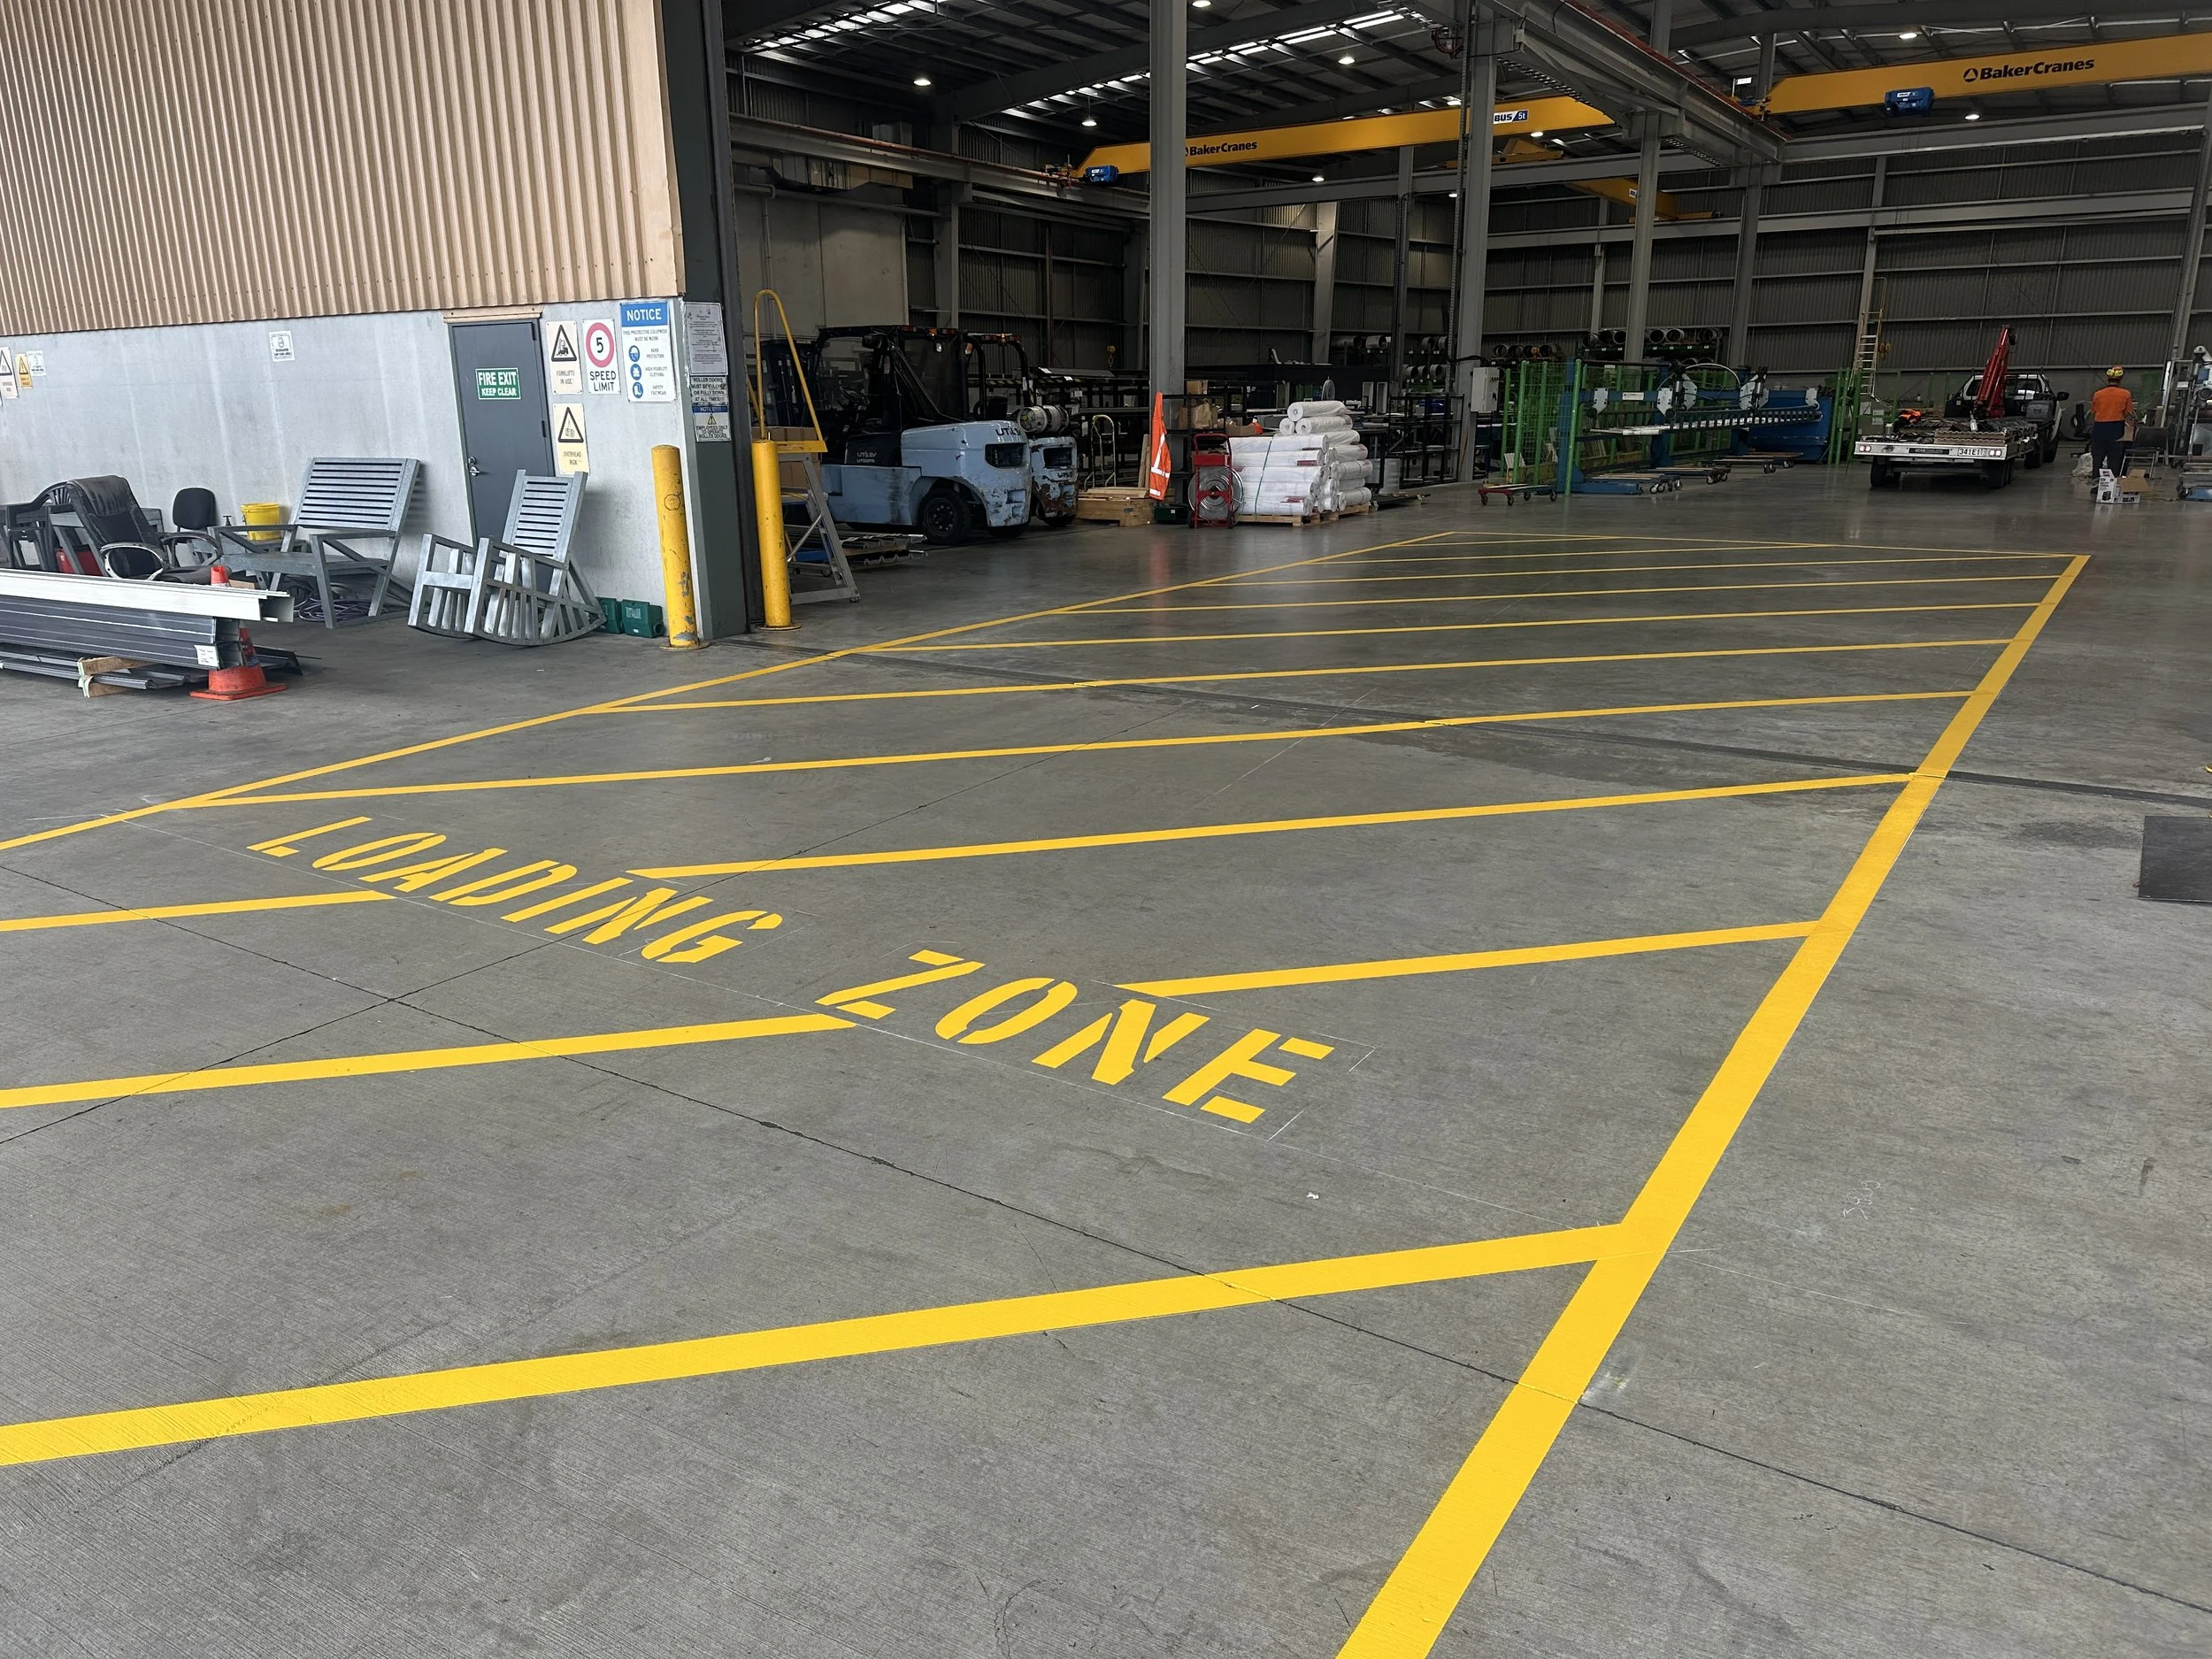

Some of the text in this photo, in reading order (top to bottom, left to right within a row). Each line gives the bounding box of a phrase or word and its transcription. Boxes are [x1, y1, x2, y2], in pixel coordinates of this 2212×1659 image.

[1979, 59, 2095, 81] BakerCranes
[1494, 113, 1512, 122] BUS
[1189, 141, 1257, 157] BakerCranes
[626, 308, 662, 321] NOTICE
[595, 337, 604, 354] 5
[478, 371, 517, 386] FIRE EXIT
[589, 370, 617, 381] SPEED
[480, 387, 518, 396] KEEP CLEAR
[593, 381, 615, 392] LIMIT
[246, 815, 783, 964] LOADING
[814, 949, 1335, 1124] ZONE
